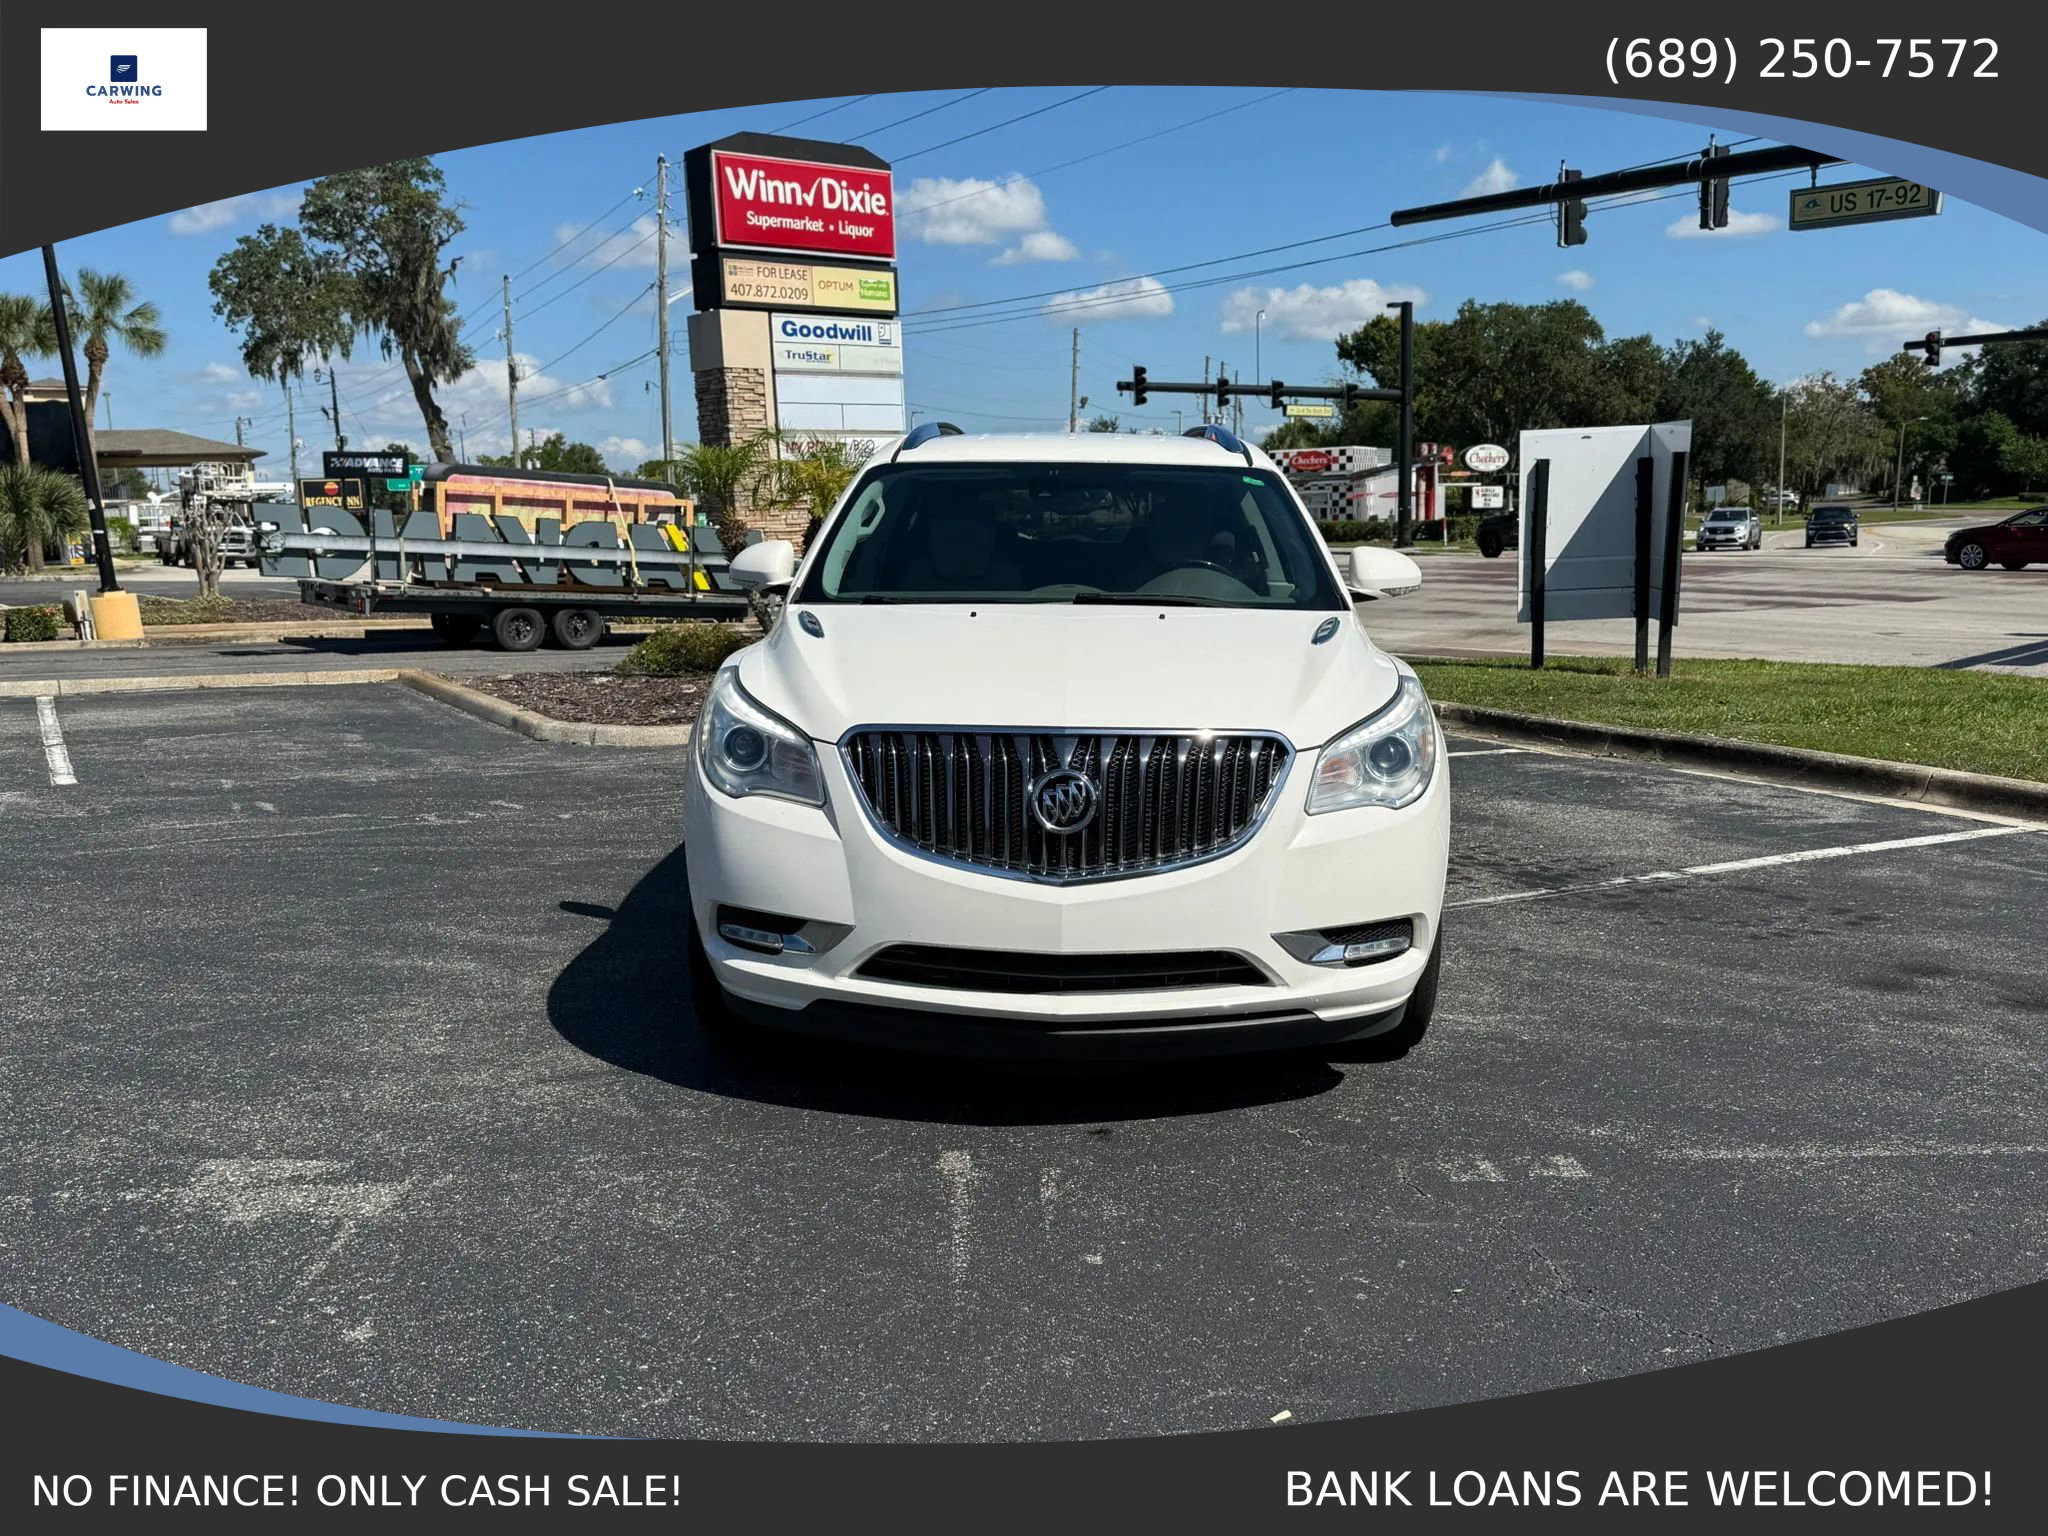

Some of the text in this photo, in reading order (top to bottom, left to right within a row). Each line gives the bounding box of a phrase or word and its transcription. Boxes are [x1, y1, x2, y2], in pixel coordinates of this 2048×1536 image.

[725, 166, 887, 216] Winn Dixie
[1830, 192, 1857, 214] US
[1867, 183, 1921, 210] 17-92
[746, 210, 875, 239] Supermarket Liquor
[756, 266, 778, 278] FOR
[779, 267, 808, 281] LEASE
[730, 283, 809, 300] 407.872.0209
[818, 279, 854, 292] OPTUM
[781, 319, 873, 342] Goodwill
[785, 349, 832, 362] TruStar
[344, 457, 404, 468] ADVANCE
[1291, 455, 1328, 465] Checkers
[1470, 452, 1506, 463] Checkers
[305, 496, 343, 508] REGENCY
